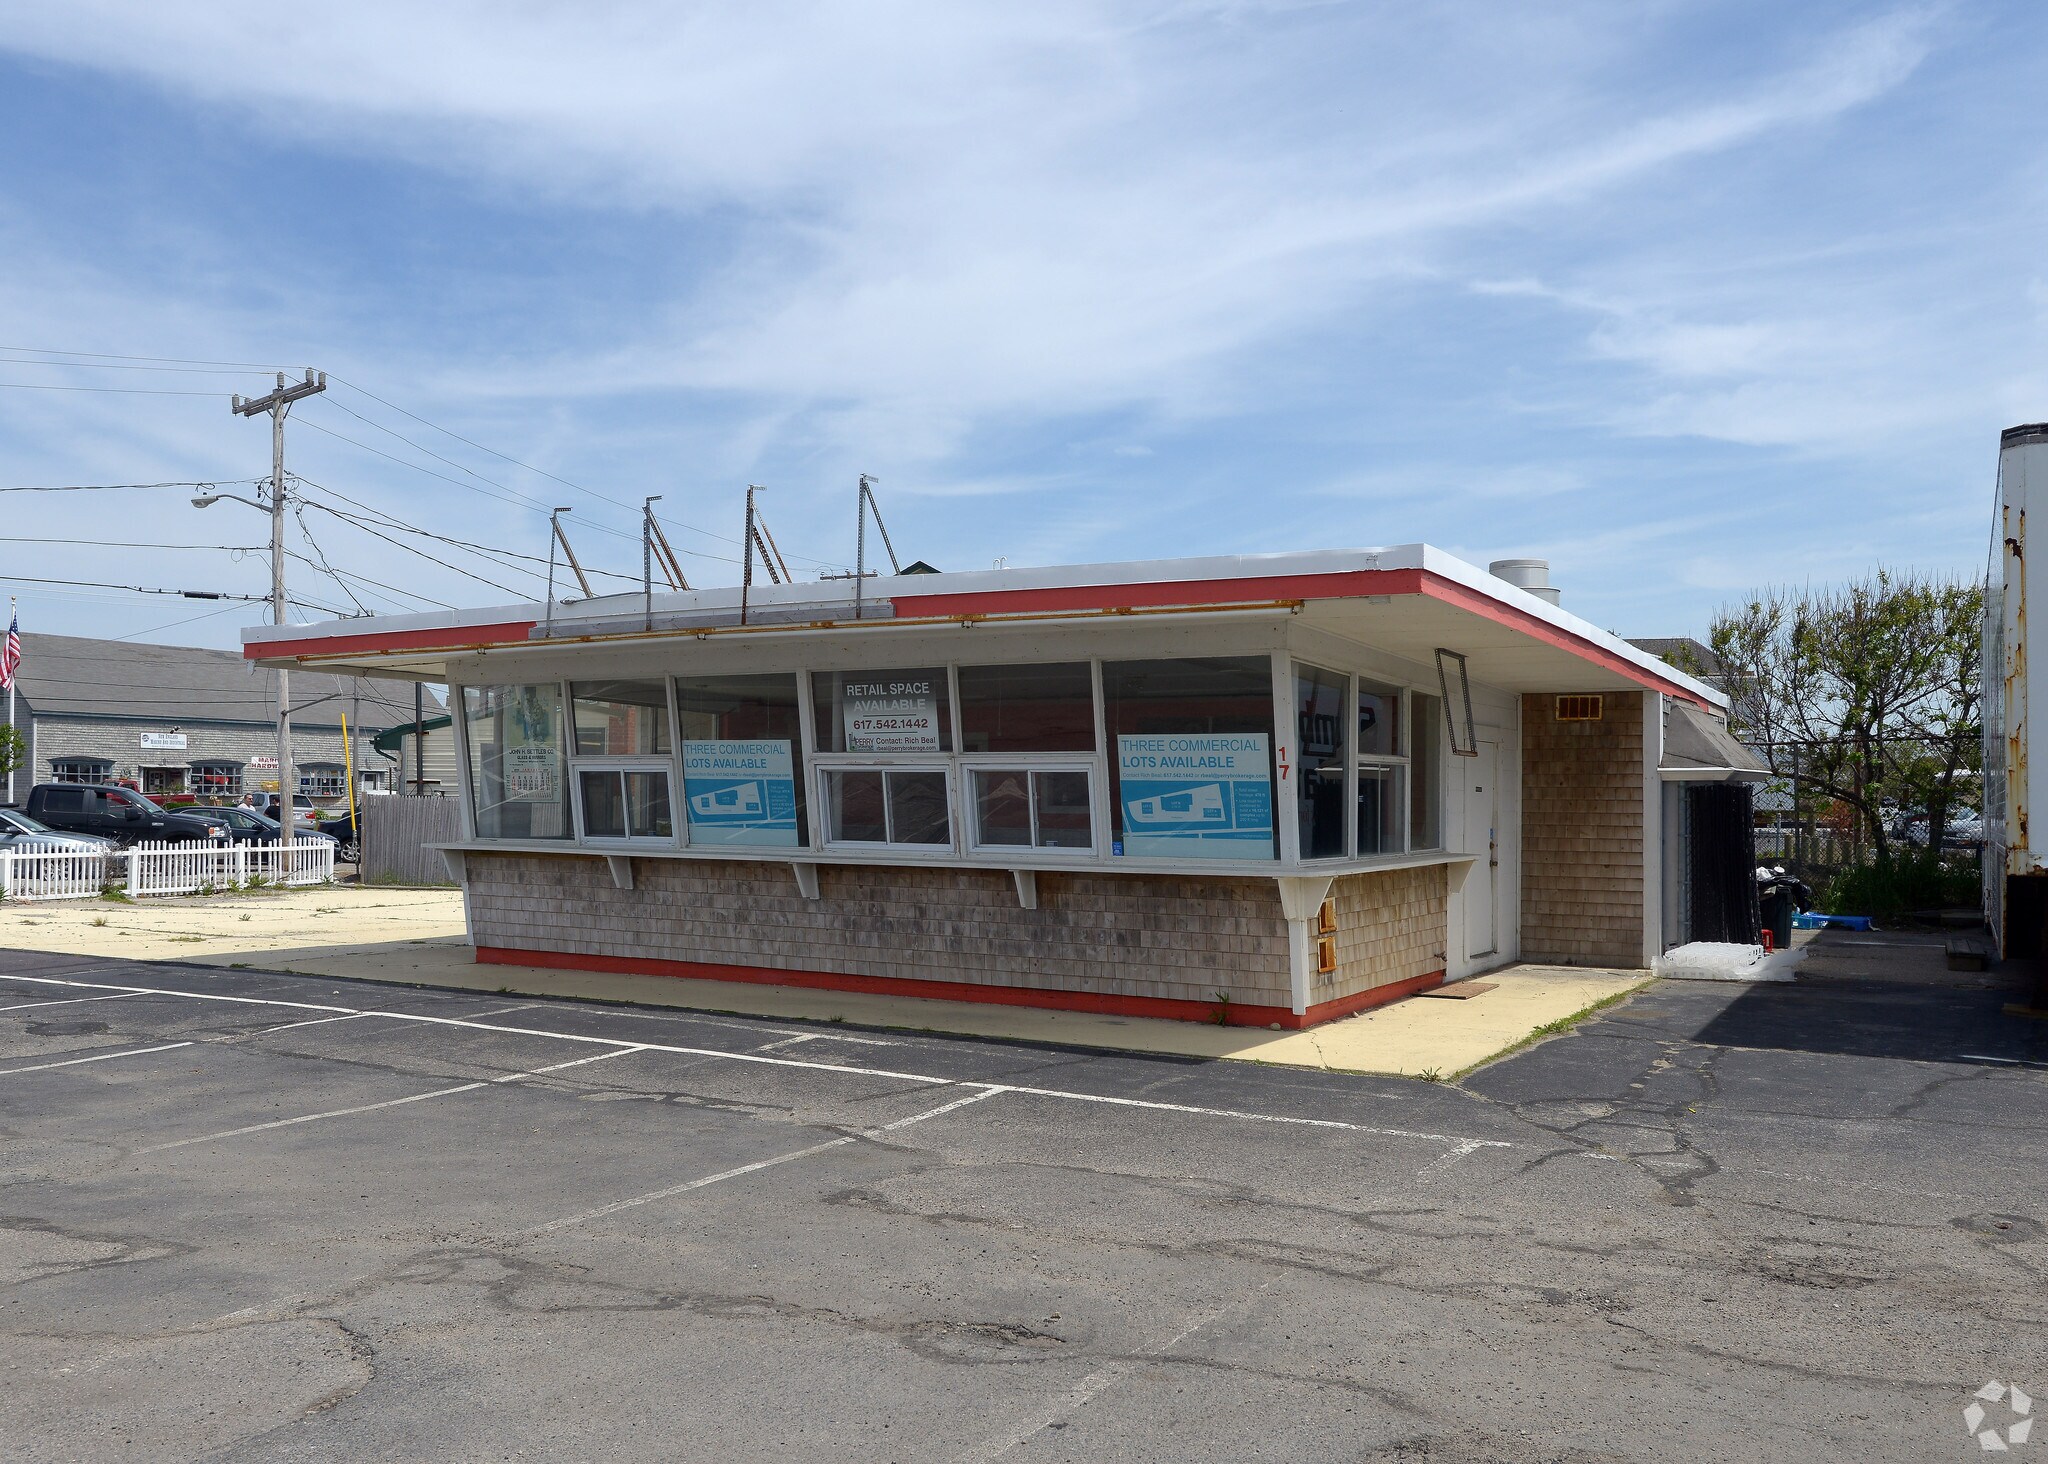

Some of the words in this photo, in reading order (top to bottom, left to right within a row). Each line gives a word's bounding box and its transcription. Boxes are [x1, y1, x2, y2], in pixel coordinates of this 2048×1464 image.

[846, 684, 887, 696] RETAIL
[889, 682, 930, 695] SPACE
[853, 698, 926, 712] AVAILABLE
[853, 718, 928, 730] 617.542.1442
[876, 737, 902, 745] Contact:
[921, 736, 936, 744] Beal
[1121, 740, 1165, 752] THREE
[1168, 739, 1261, 751] COMMERCIAL
[684, 744, 717, 755] THREE
[719, 744, 785, 755] COMMERCIAL
[686, 759, 711, 769] LOTS
[713, 759, 767, 769] AVAILABLE
[1122, 757, 1157, 768] LOTS
[1160, 756, 1235, 768] AVAILABLE
